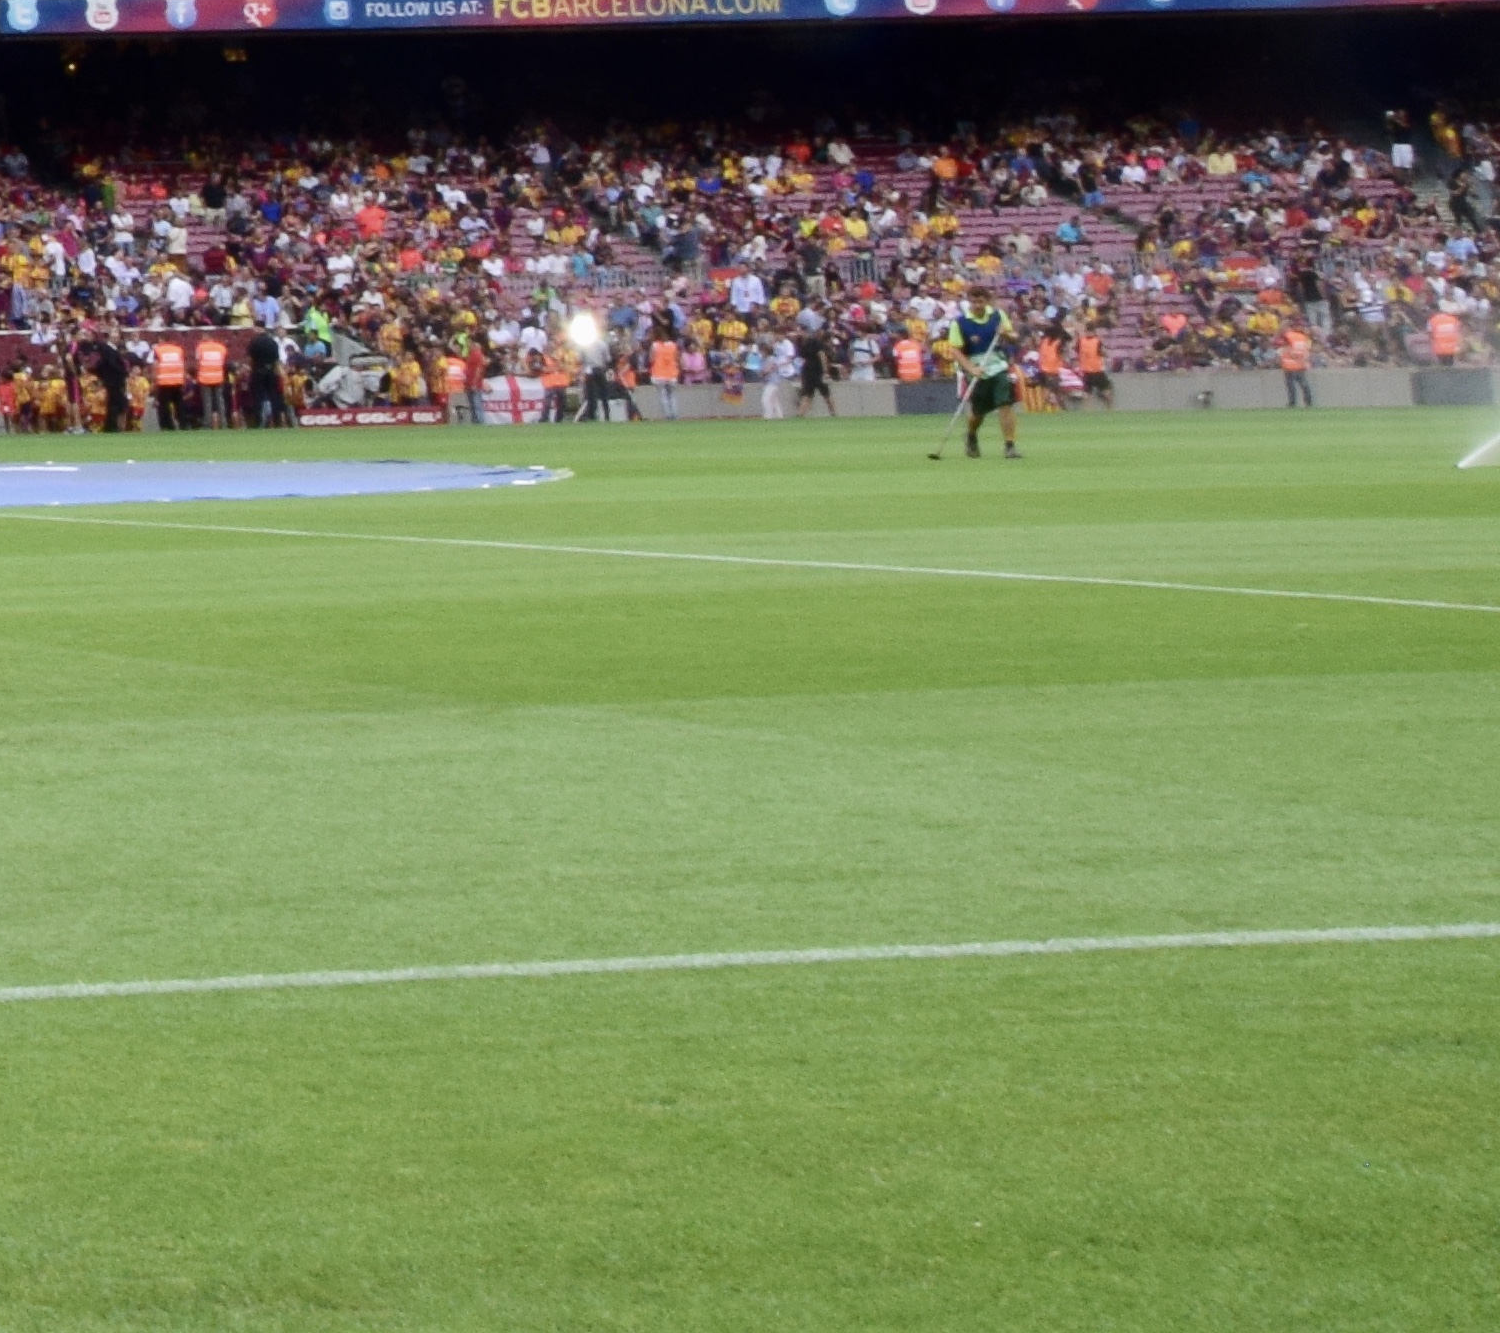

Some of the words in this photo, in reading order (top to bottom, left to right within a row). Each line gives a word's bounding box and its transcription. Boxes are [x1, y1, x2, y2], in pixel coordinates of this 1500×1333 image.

[366, 1, 431, 18] FOLLOW
[434, 1, 456, 17] US
[459, 0, 484, 16] AT:
